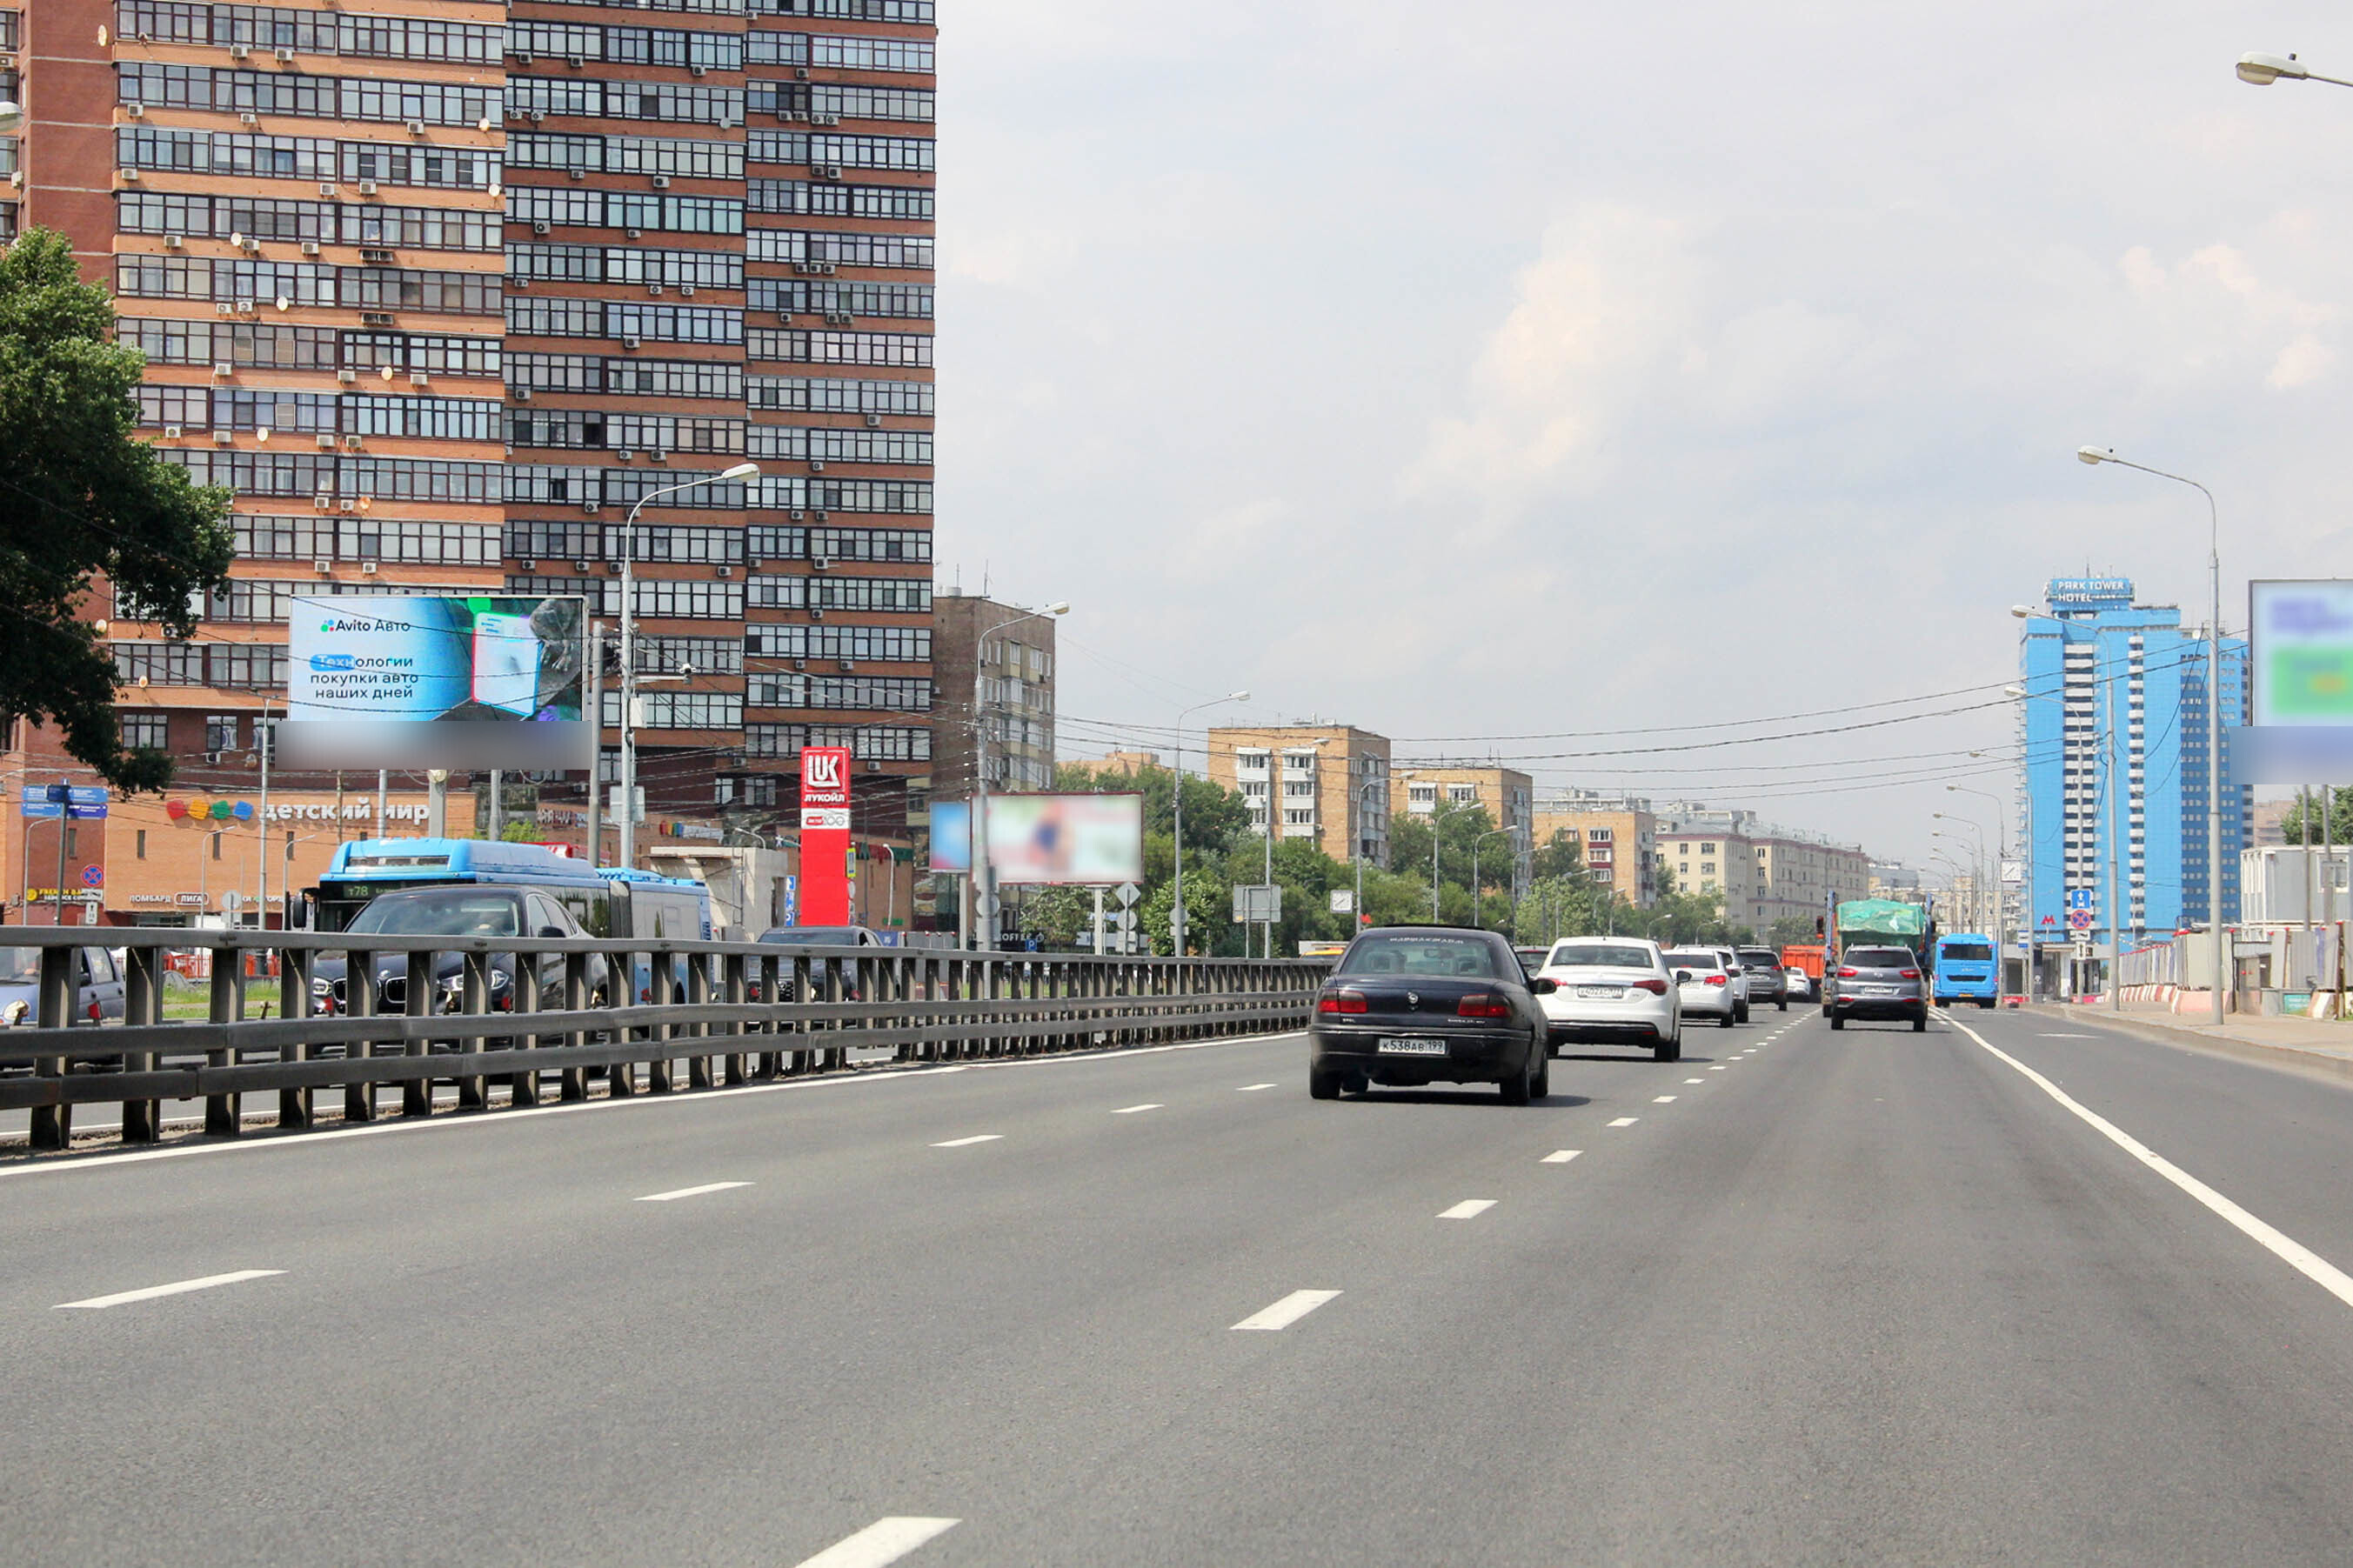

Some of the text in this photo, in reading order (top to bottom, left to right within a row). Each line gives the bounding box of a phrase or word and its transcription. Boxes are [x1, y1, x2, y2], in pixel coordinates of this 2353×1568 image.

[2058, 581, 2124, 591] PARK TOWER
[2058, 593, 2092, 603] HOTEL
[336, 619, 411, 631] Avito Авто
[318, 656, 413, 668] Технологии
[311, 674, 418, 687] покупки авто
[316, 684, 413, 700] наших дней
[804, 791, 846, 803] ЛУКОЙЛ
[260, 797, 371, 822] детский
[130, 894, 203, 904] ЛОМБАРД ЛИГА
[1428, 1040, 1443, 1051] 199
